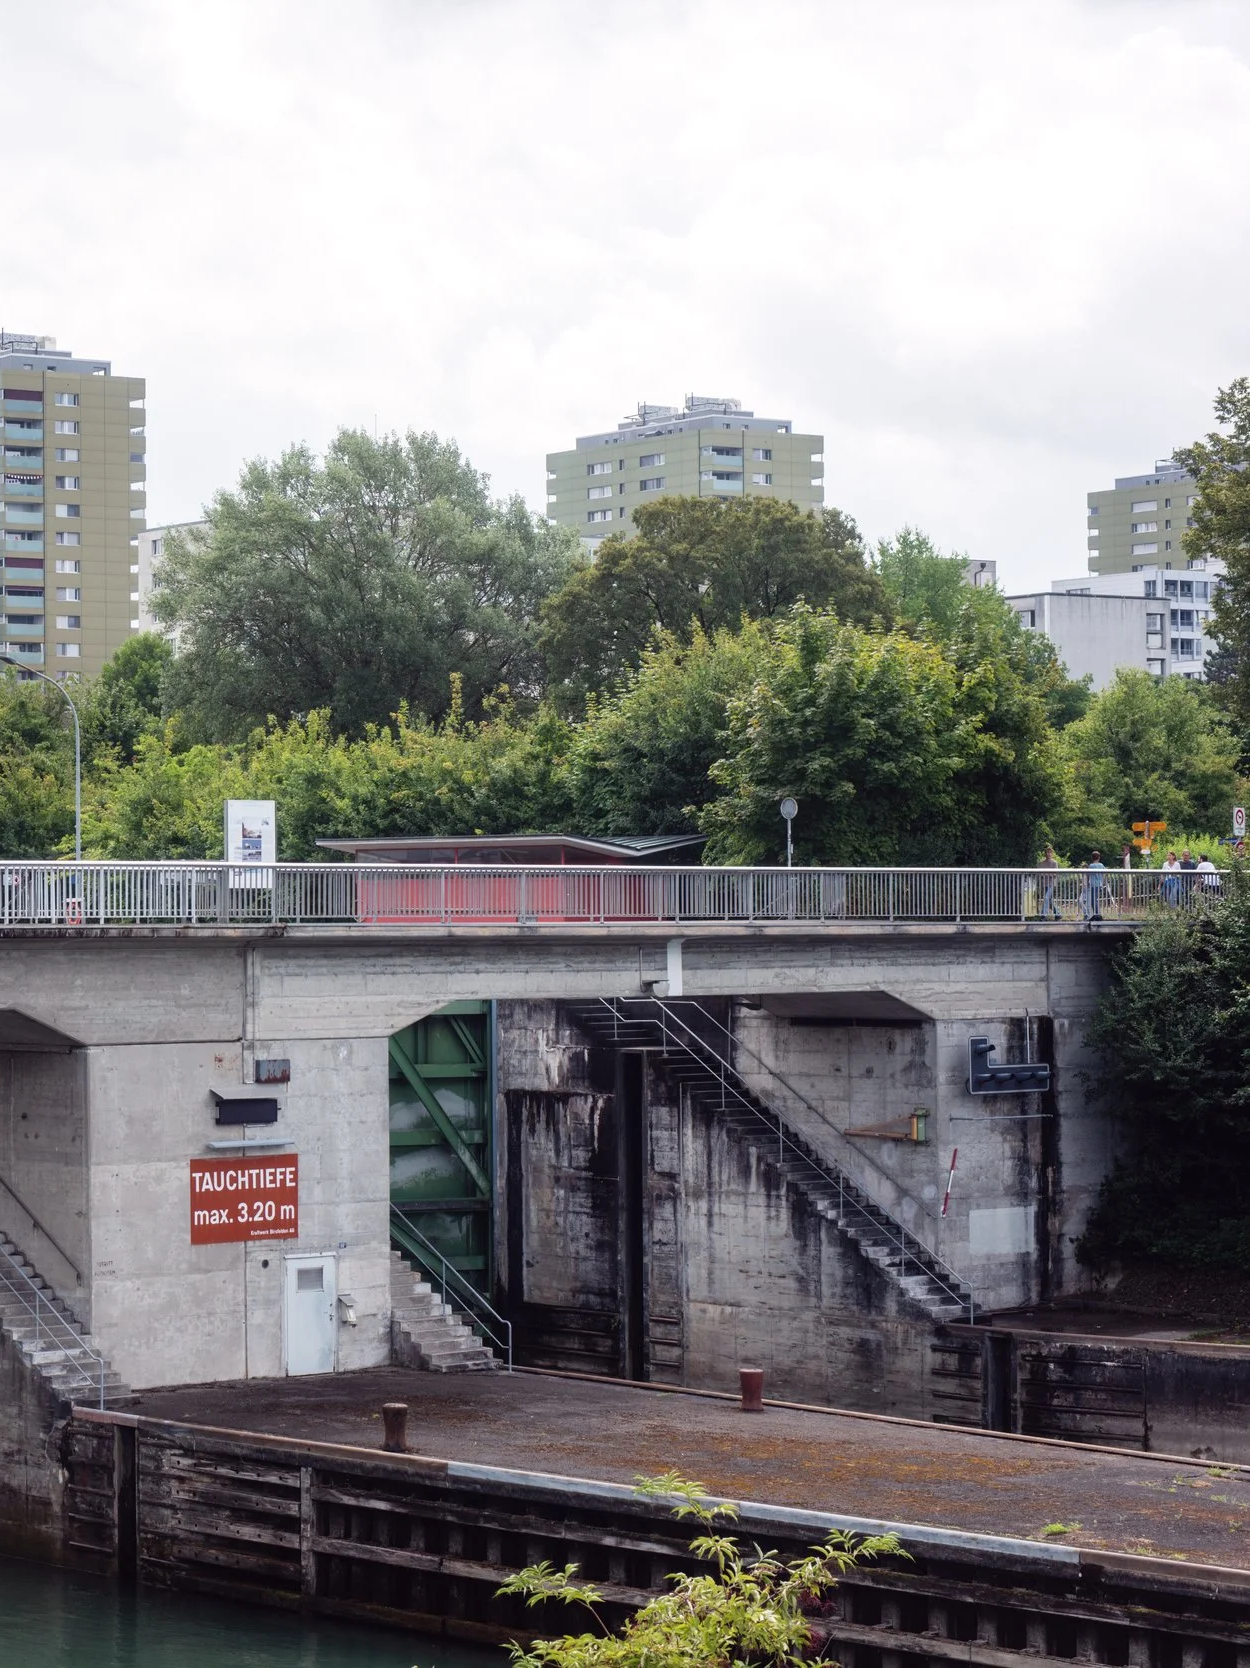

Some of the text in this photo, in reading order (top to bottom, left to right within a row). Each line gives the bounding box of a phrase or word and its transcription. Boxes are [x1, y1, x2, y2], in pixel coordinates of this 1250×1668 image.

[192, 1167, 296, 1192] TAUCHTIEFE
[194, 1201, 295, 1225] max. 3.20 m
